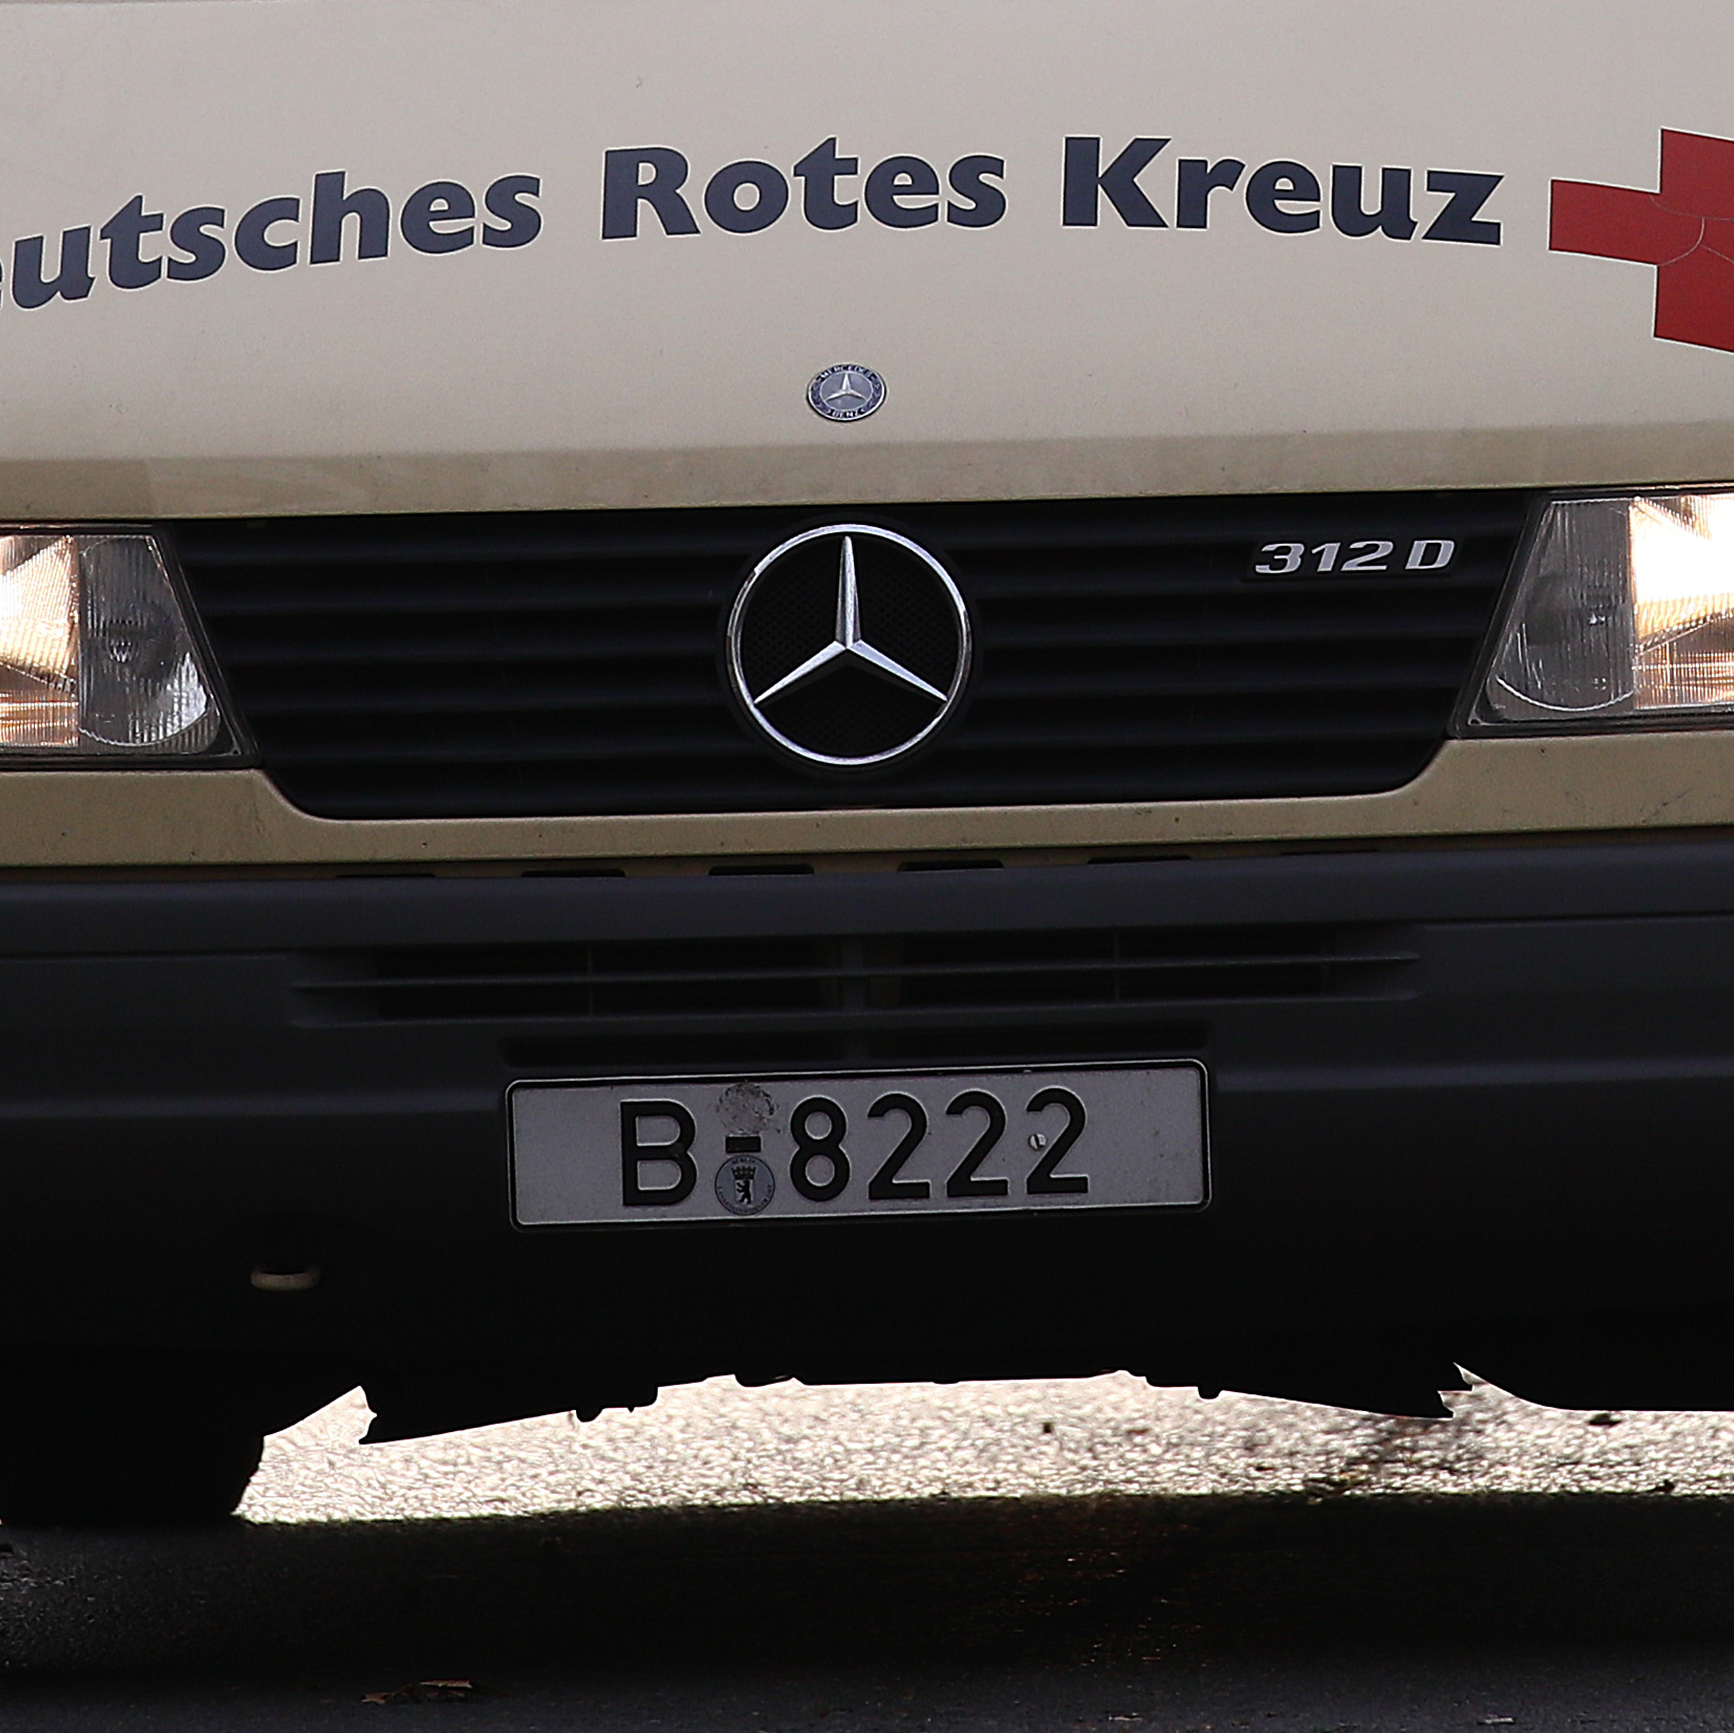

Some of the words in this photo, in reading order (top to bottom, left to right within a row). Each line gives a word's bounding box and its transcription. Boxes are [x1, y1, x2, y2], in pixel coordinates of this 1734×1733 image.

[601, 136, 1007, 241] Rotes
[1062, 136, 1505, 246] Kreuz
[1254, 539, 1394, 575] 312
[1404, 539, 1456, 571] D
